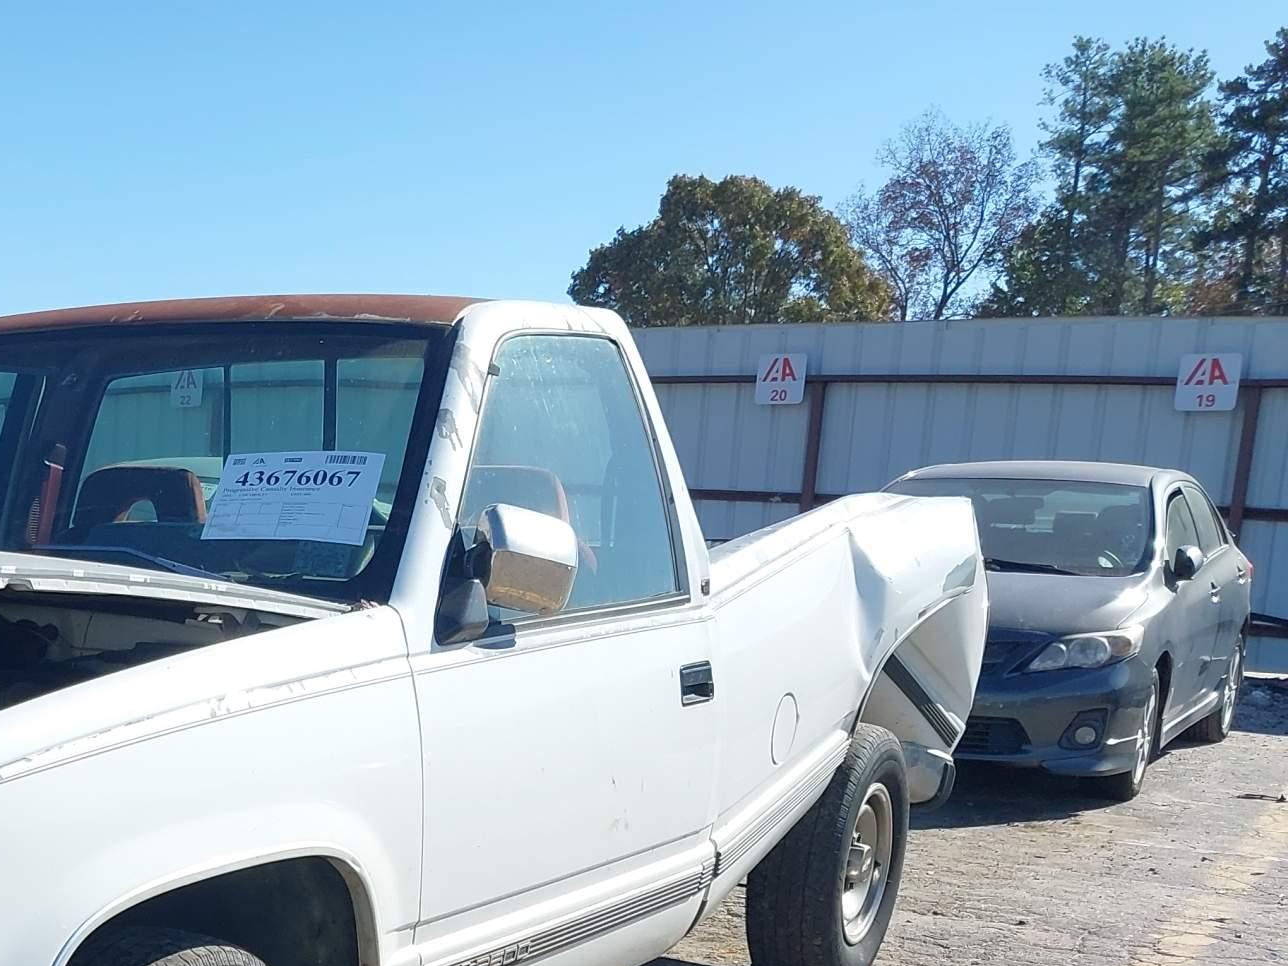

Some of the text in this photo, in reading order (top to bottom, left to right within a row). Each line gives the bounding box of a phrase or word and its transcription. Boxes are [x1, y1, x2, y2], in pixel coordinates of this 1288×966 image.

[770, 389, 787, 401] 20
[1196, 394, 1216, 408] 19
[235, 469, 361, 488] 43676067
